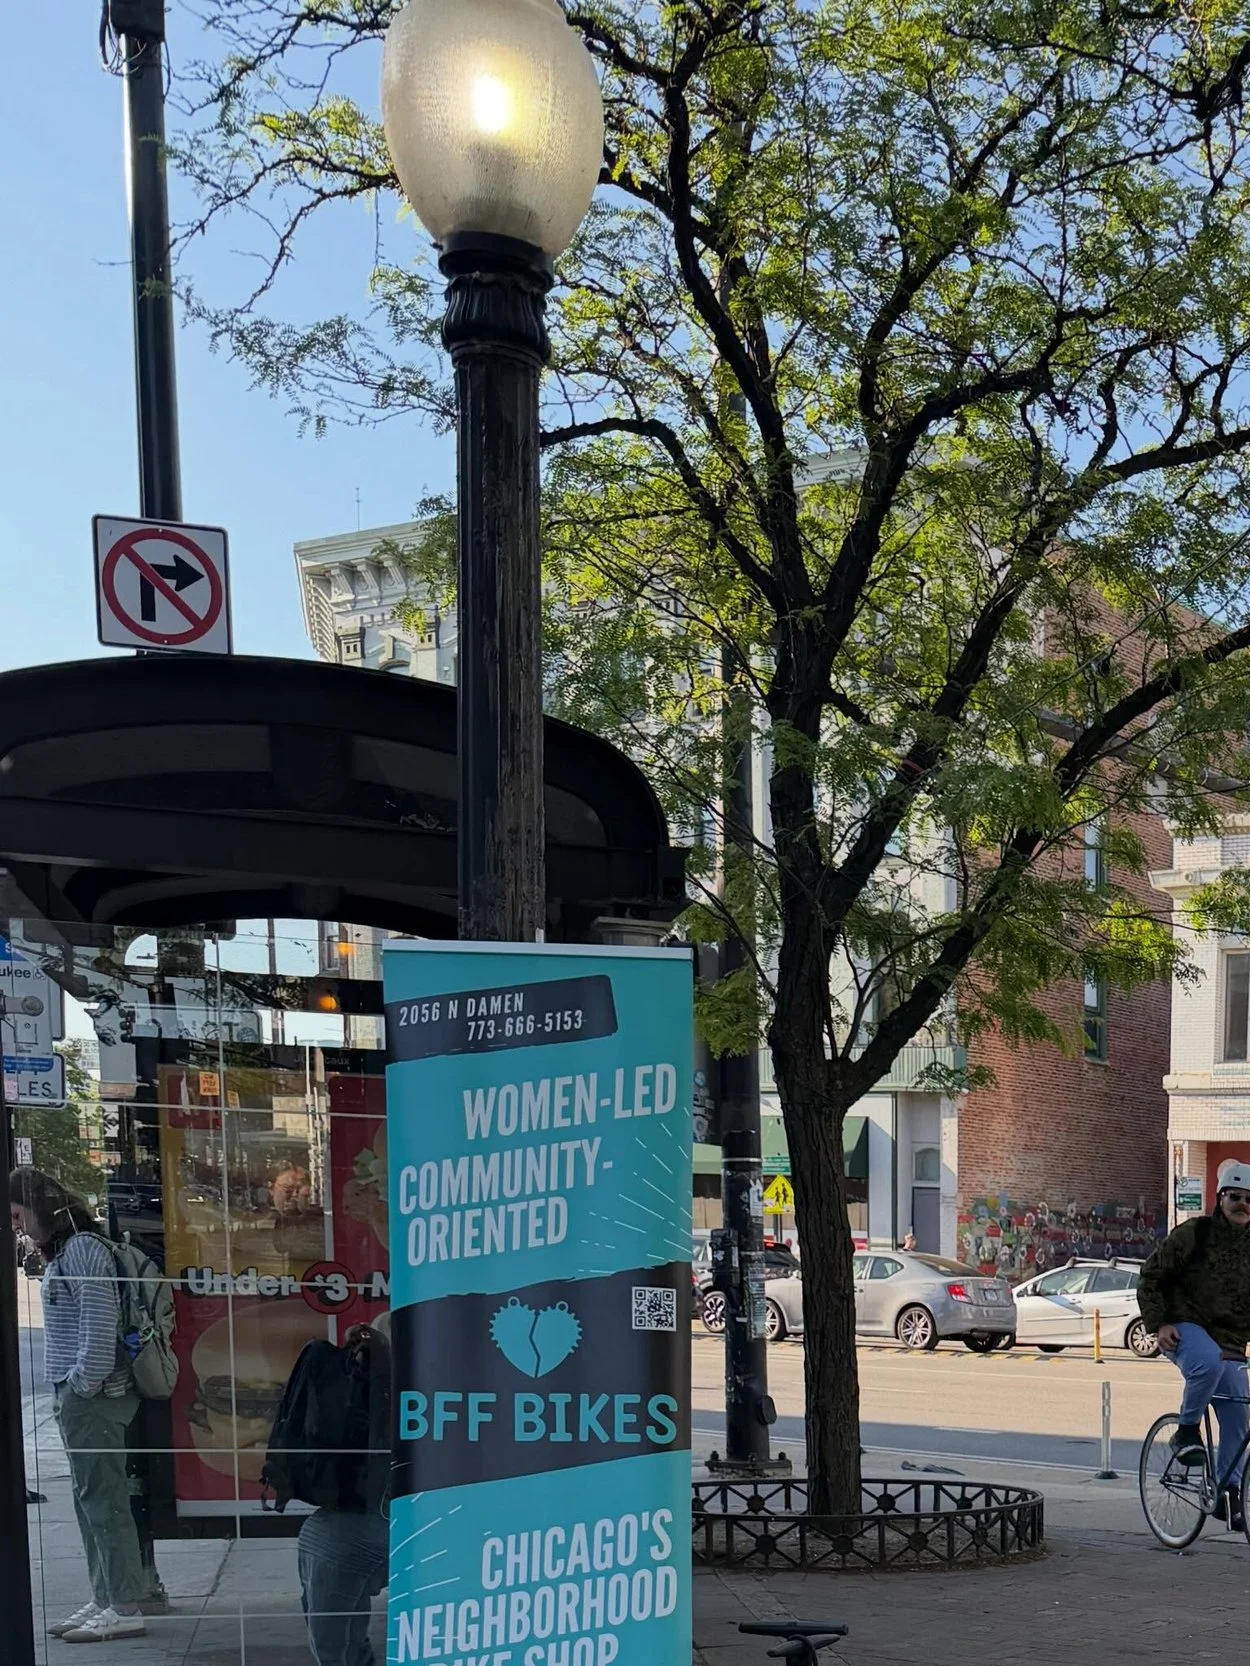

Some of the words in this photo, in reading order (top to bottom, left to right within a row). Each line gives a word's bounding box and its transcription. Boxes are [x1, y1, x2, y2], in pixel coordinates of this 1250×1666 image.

[399, 1002, 441, 1027] 2056
[448, 998, 459, 1019] N
[466, 993, 525, 1018] DAMEN
[467, 1010, 584, 1042] 773-666-5153
[463, 1063, 676, 1140] WOMEN-LED
[400, 1137, 613, 1214] COMMUNITY-
[408, 1196, 568, 1266] ORIENTED
[186, 1266, 296, 1297] Under
[315, 1272, 350, 1302] $3
[400, 1391, 496, 1442] BFF
[514, 1392, 678, 1444] BIKES
[482, 1508, 672, 1591] CHICAGO'S
[398, 1565, 677, 1663] NEIGHBORHOOD
